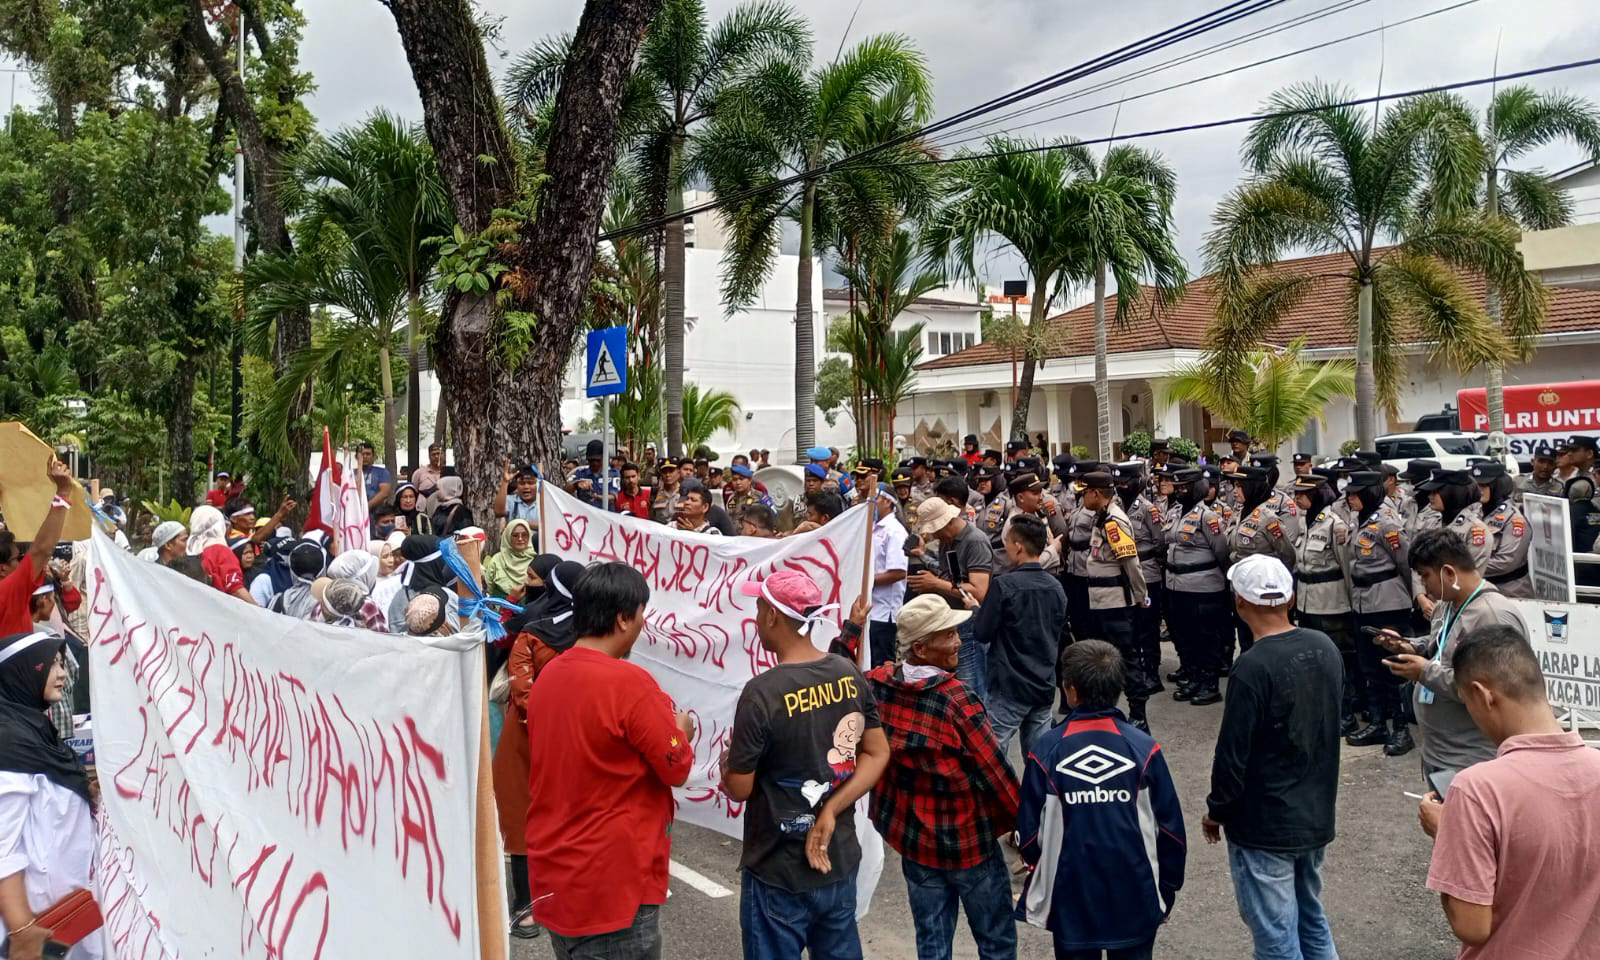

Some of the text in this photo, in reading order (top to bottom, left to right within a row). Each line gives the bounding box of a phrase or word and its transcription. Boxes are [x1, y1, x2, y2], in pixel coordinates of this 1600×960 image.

[1474, 411, 1539, 430] PLRI
[784, 676, 858, 717] PEANUTS
[1547, 679, 1582, 705] KACA
[1064, 786, 1131, 805] umbro
